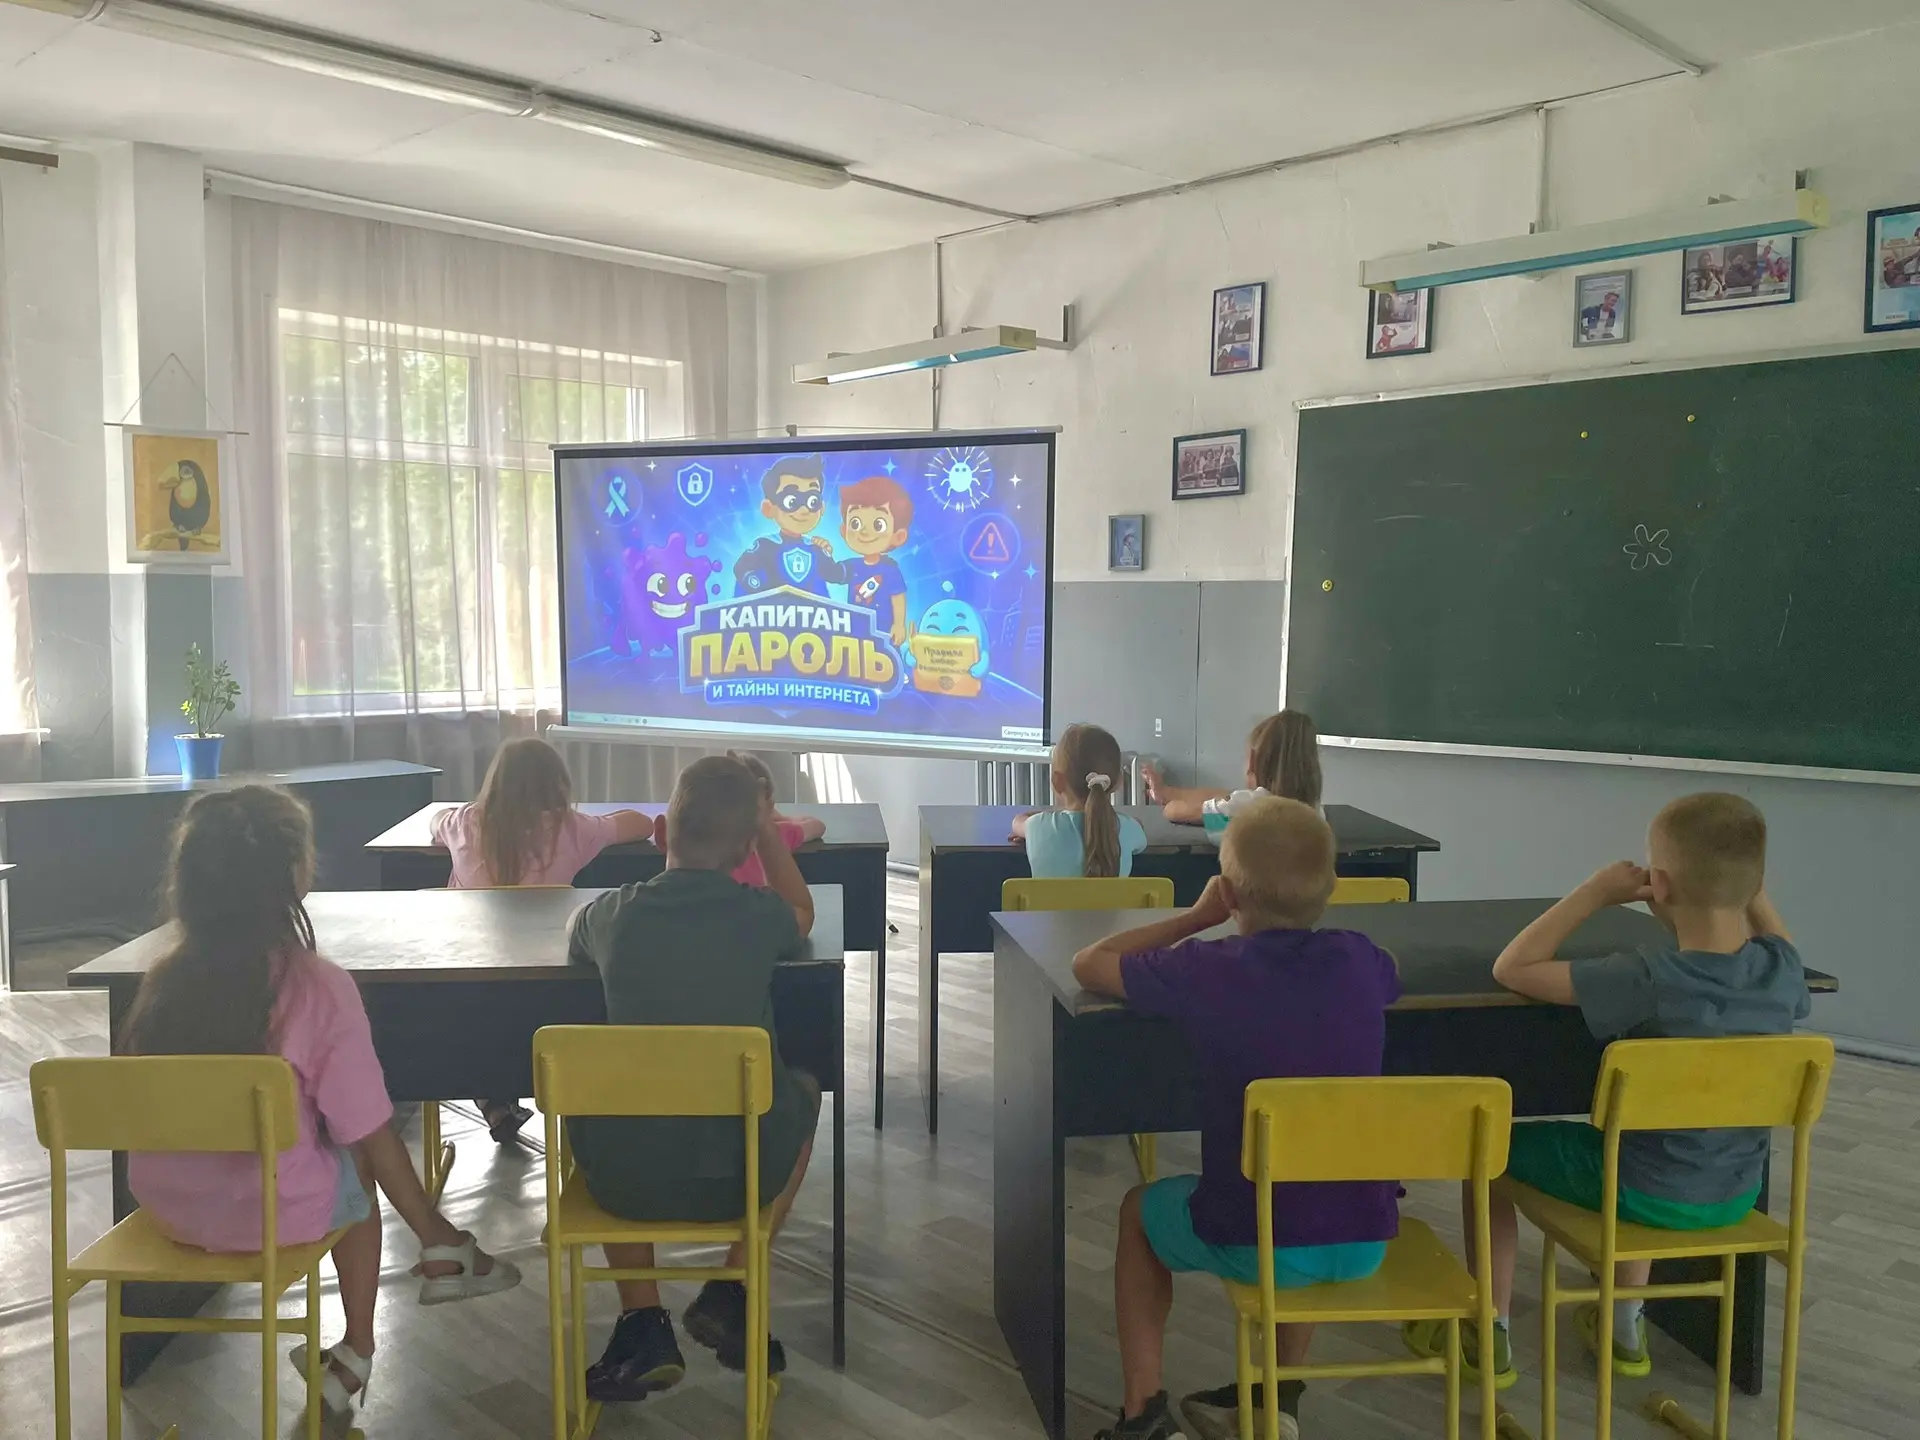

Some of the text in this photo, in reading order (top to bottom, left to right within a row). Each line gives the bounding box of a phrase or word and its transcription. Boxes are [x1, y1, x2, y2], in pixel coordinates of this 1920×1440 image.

[719, 605, 852, 633] КАПИТАН
[690, 631, 894, 683] ПАРОЛЬ
[712, 681, 871, 706] И ТАЙНЫ ИНТЕРНЕТА
